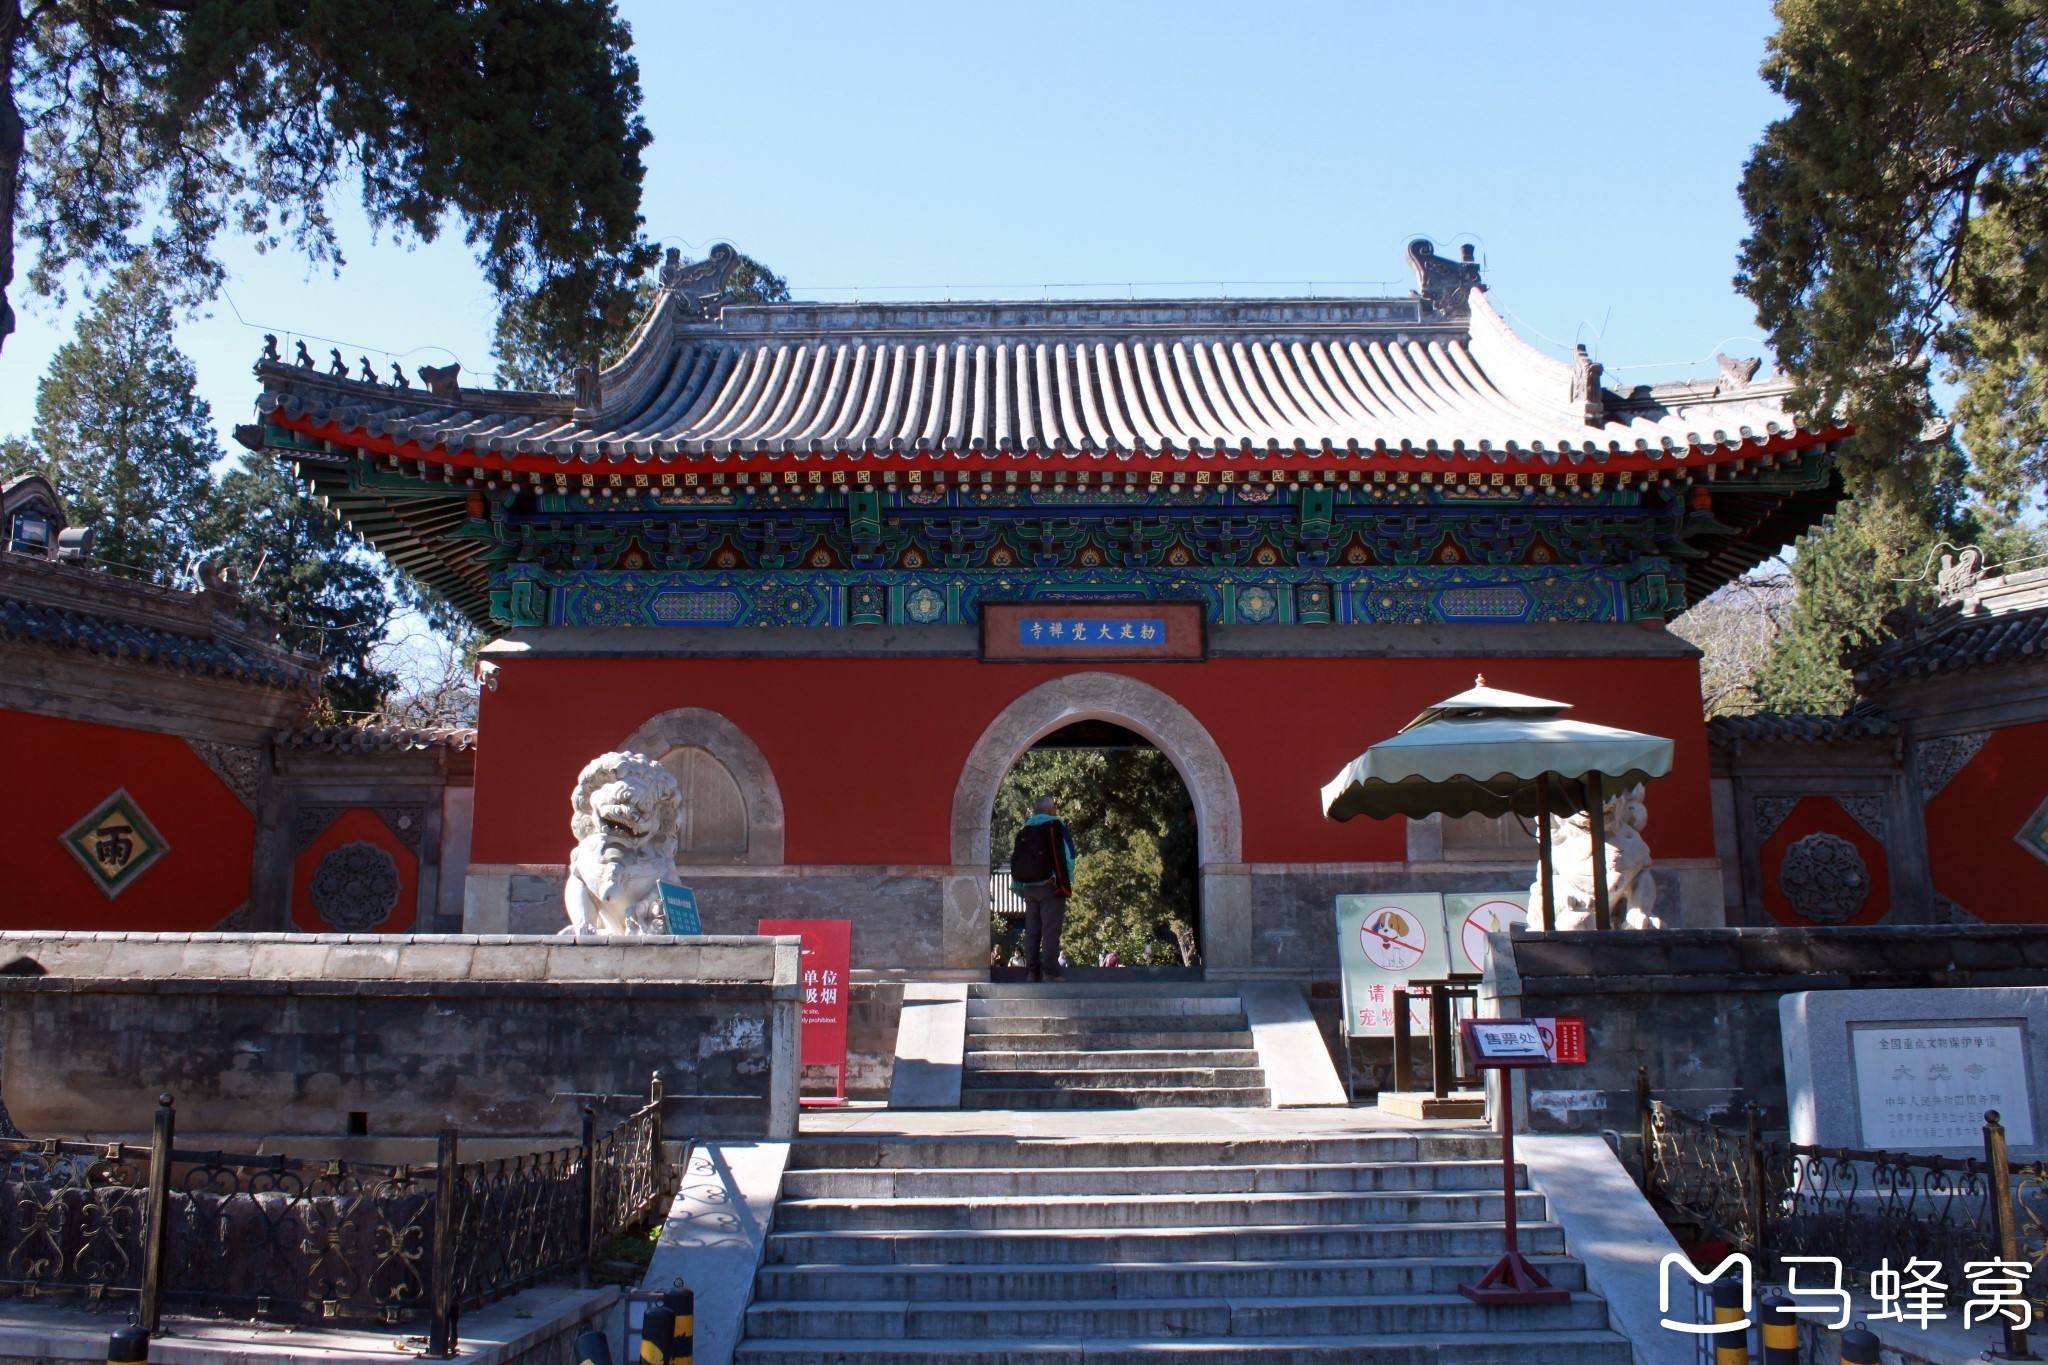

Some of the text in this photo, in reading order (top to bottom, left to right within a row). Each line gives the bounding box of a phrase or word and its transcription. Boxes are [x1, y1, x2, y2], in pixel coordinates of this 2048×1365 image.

[96, 825, 133, 866] 雨
[804, 970, 837, 986] 单位
[1485, 1032, 1537, 1046] 售票处
[1879, 1035, 1997, 1050] 全国重点文物保护单位
